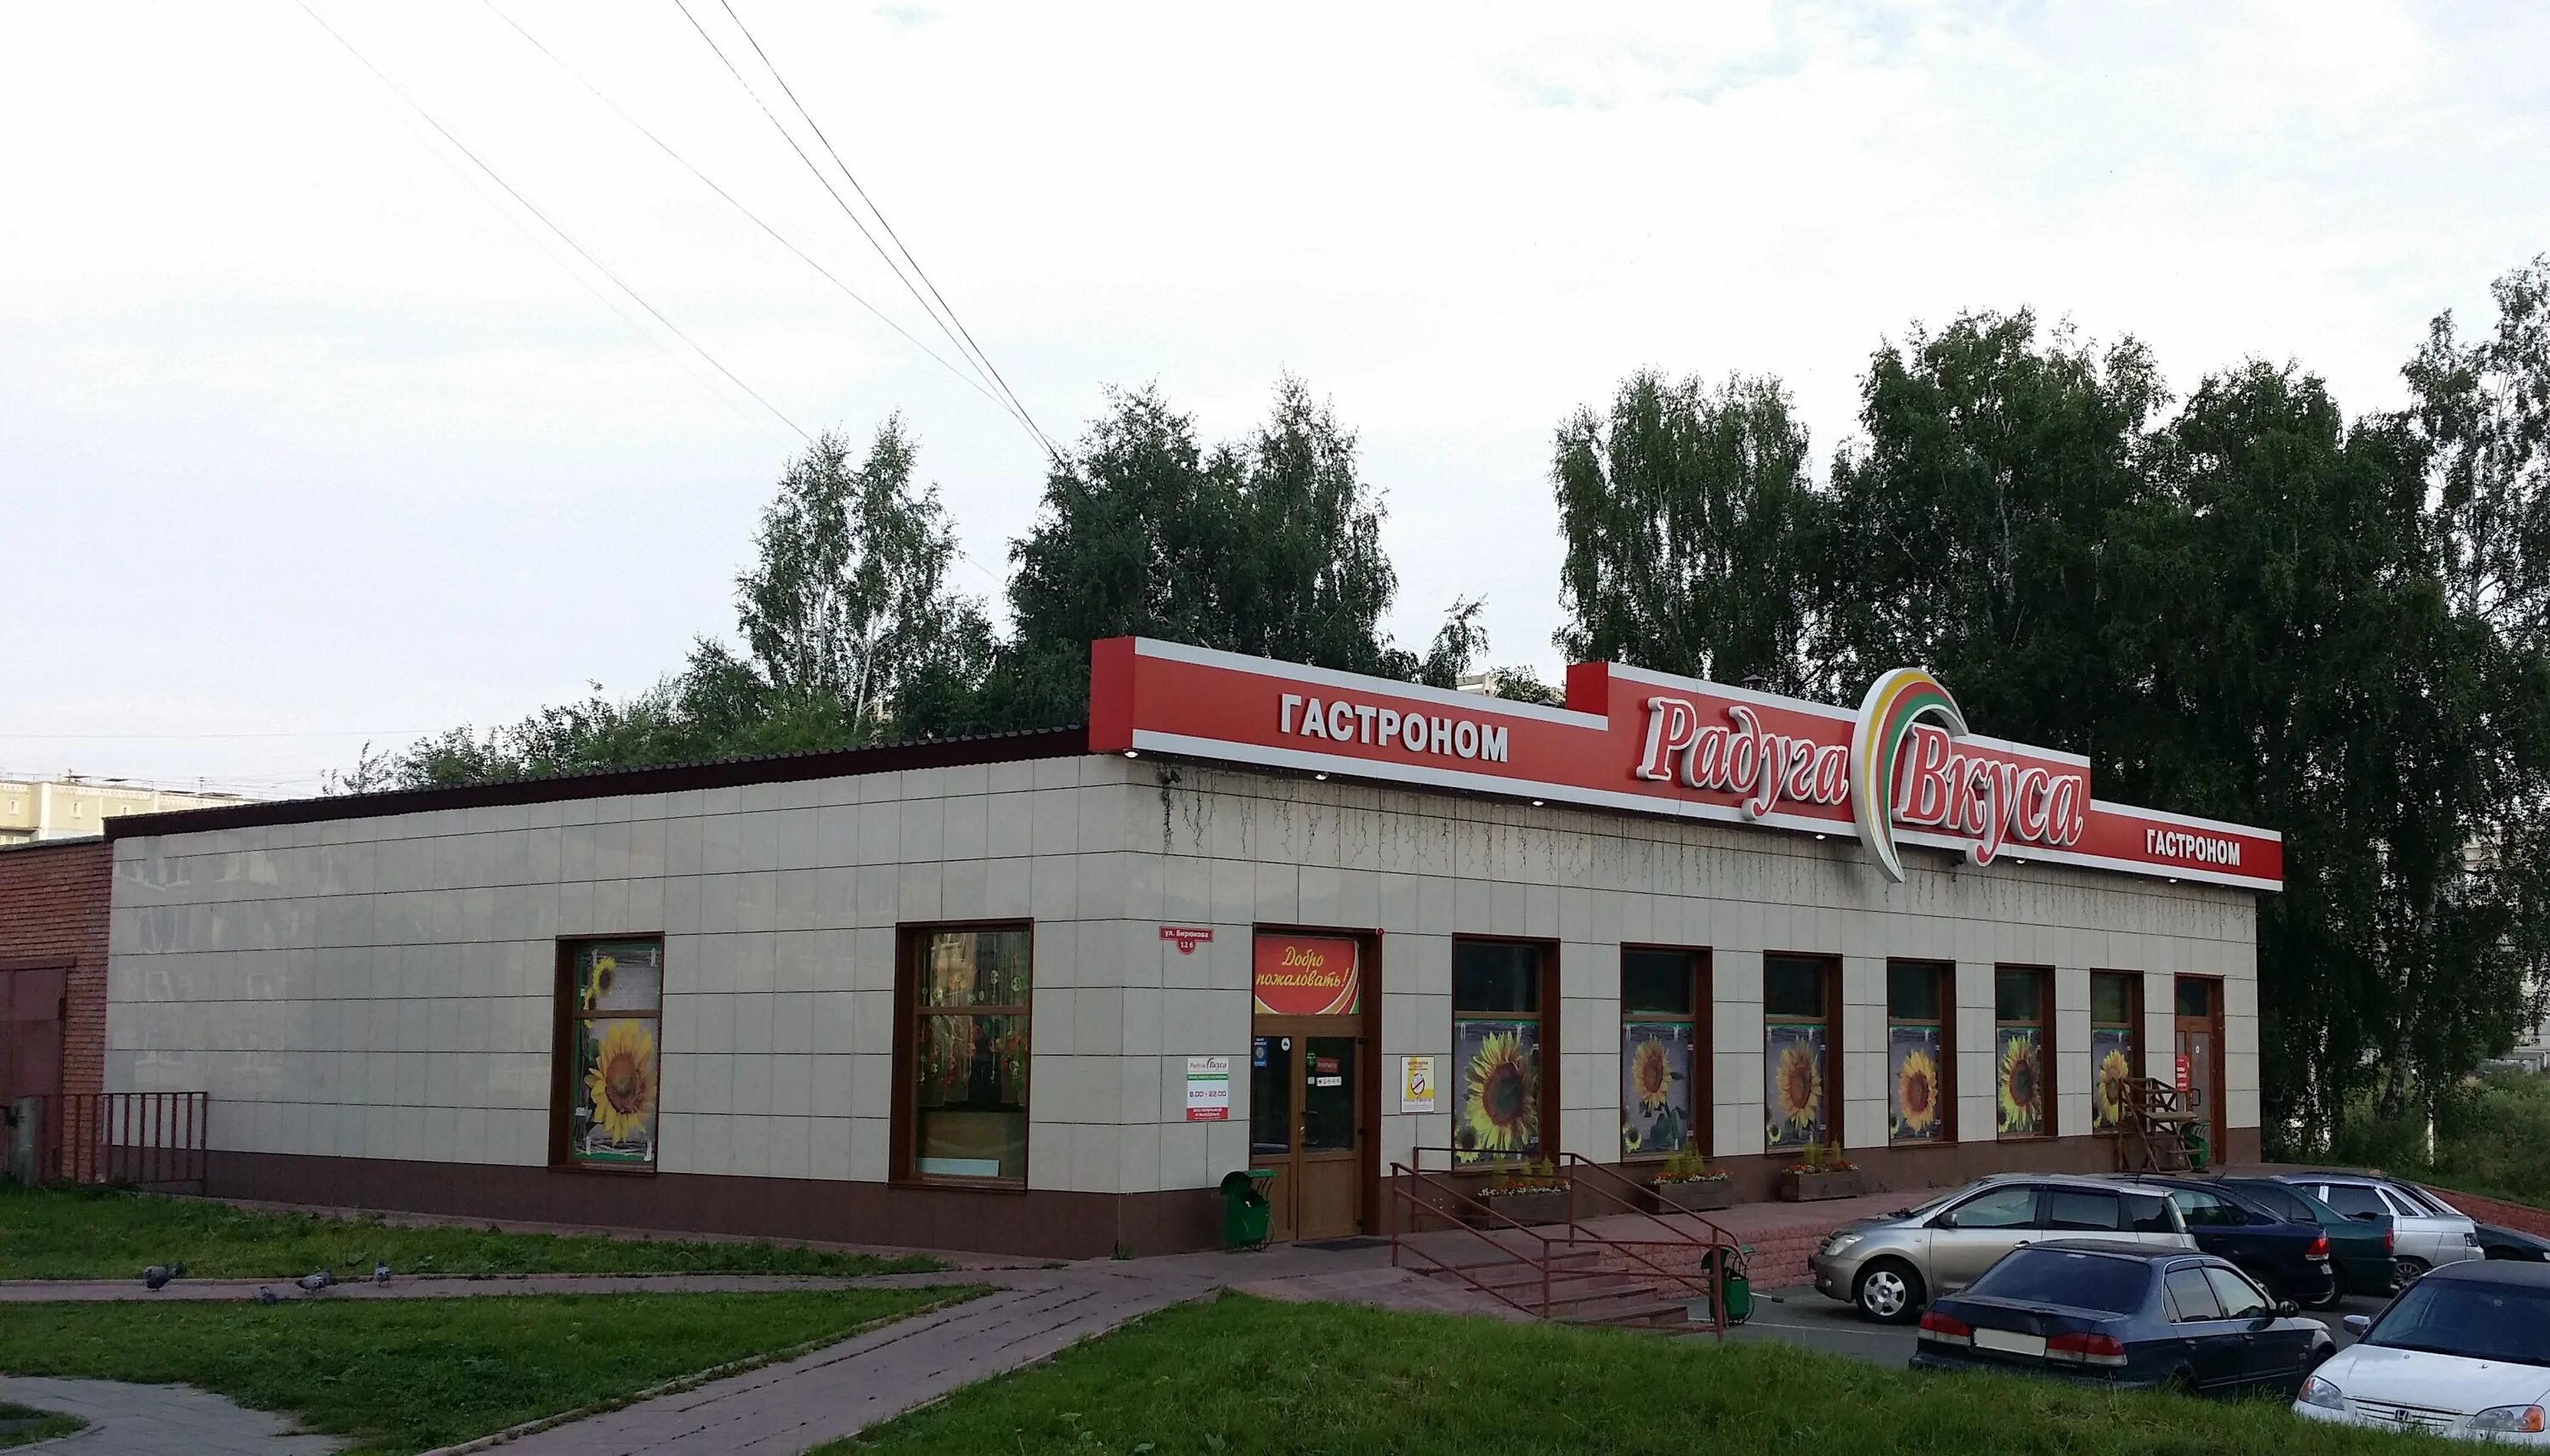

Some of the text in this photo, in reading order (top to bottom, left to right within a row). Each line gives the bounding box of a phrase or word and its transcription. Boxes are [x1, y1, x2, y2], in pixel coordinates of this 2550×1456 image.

[1280, 693, 1508, 762] ГАСТРОНОМ
[1635, 695, 2085, 867] Радуга Вкуса
[2146, 829, 2241, 866] ГАСТРОНОМ
[1176, 929, 1209, 938] Бирюкова
[1282, 946, 1324, 972] Добро
[1255, 967, 1350, 987] пожаловать!
